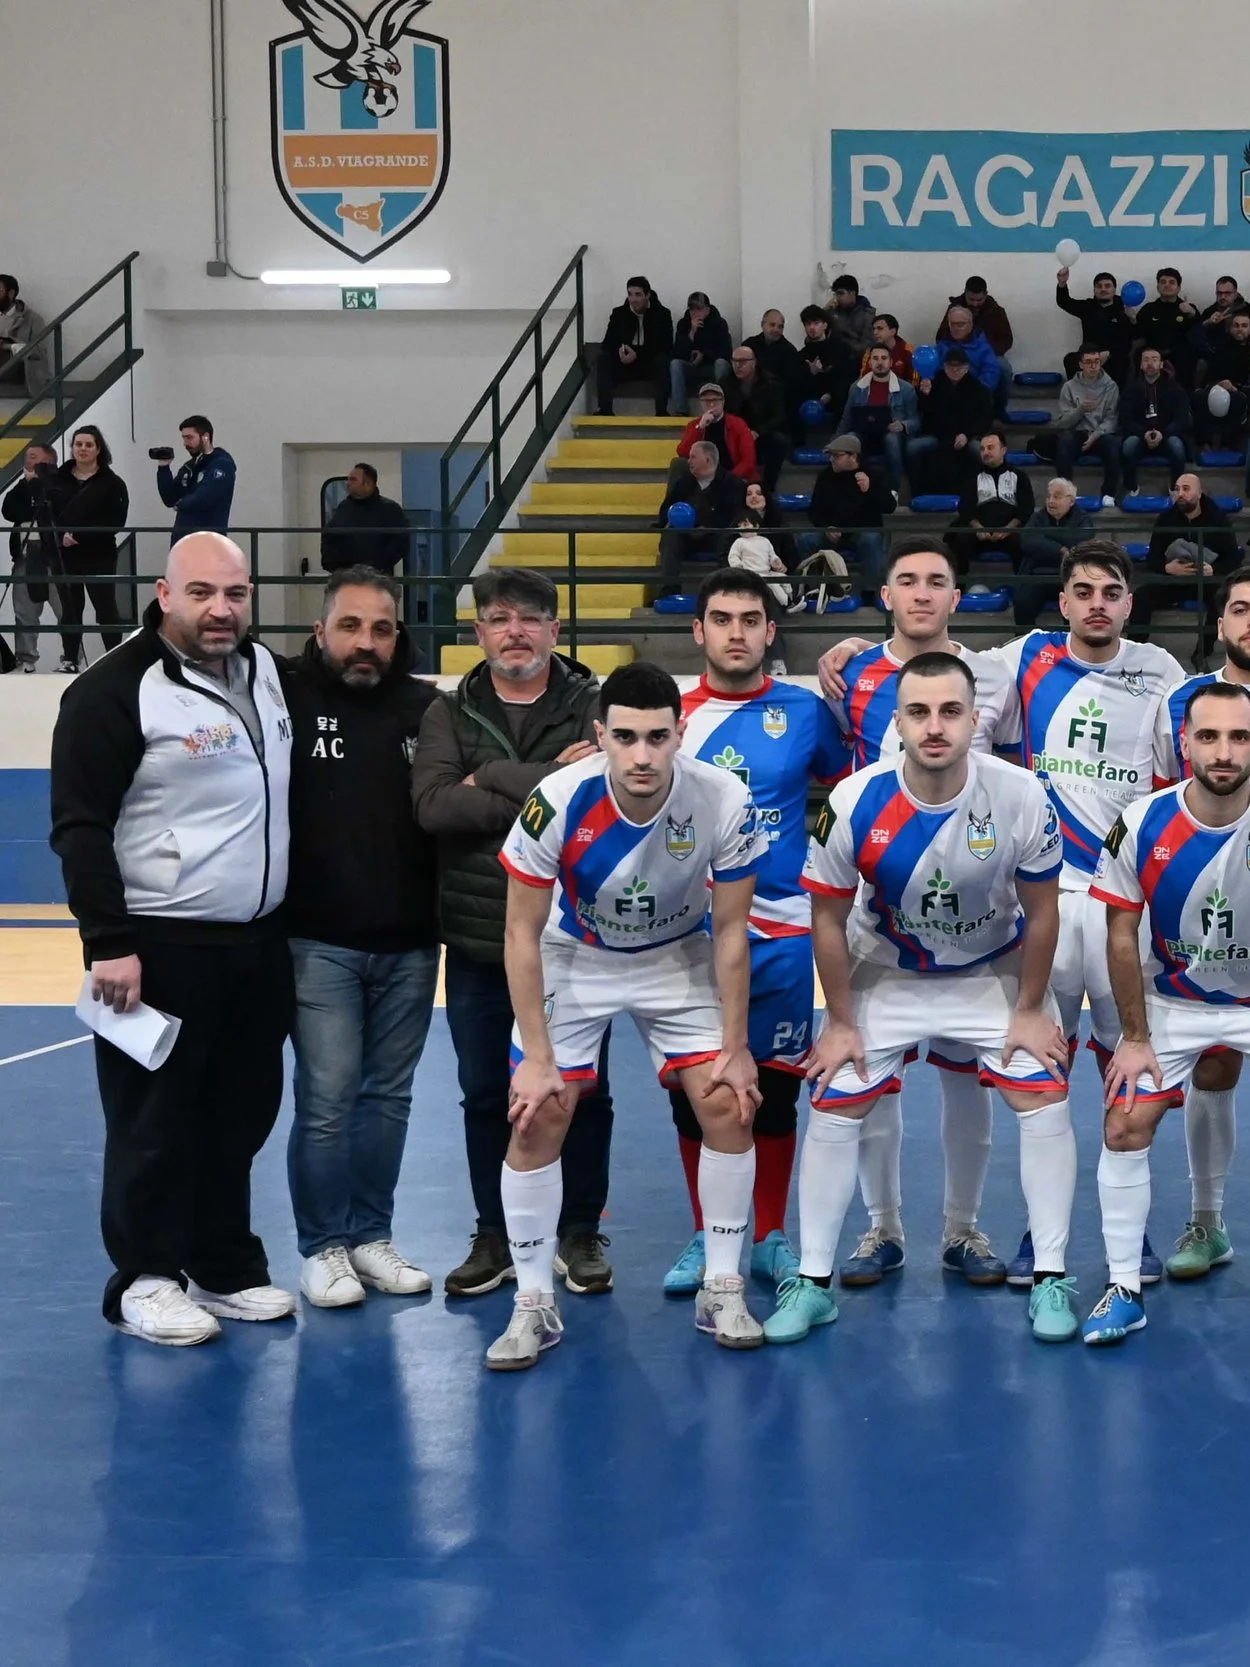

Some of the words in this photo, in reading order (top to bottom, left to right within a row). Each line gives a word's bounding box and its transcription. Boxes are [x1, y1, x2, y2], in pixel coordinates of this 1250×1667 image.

[293, 156, 336, 168] A.S.D.
[338, 155, 429, 168] VIAGRANDE
[849, 154, 1229, 228] RAGAZZI
[353, 210, 370, 220] C5
[1033, 751, 1139, 785] piantefaro
[1056, 782, 1097, 796] GREEN
[773, 1020, 808, 1050] 24
[713, 1225, 748, 1235] ONZ
